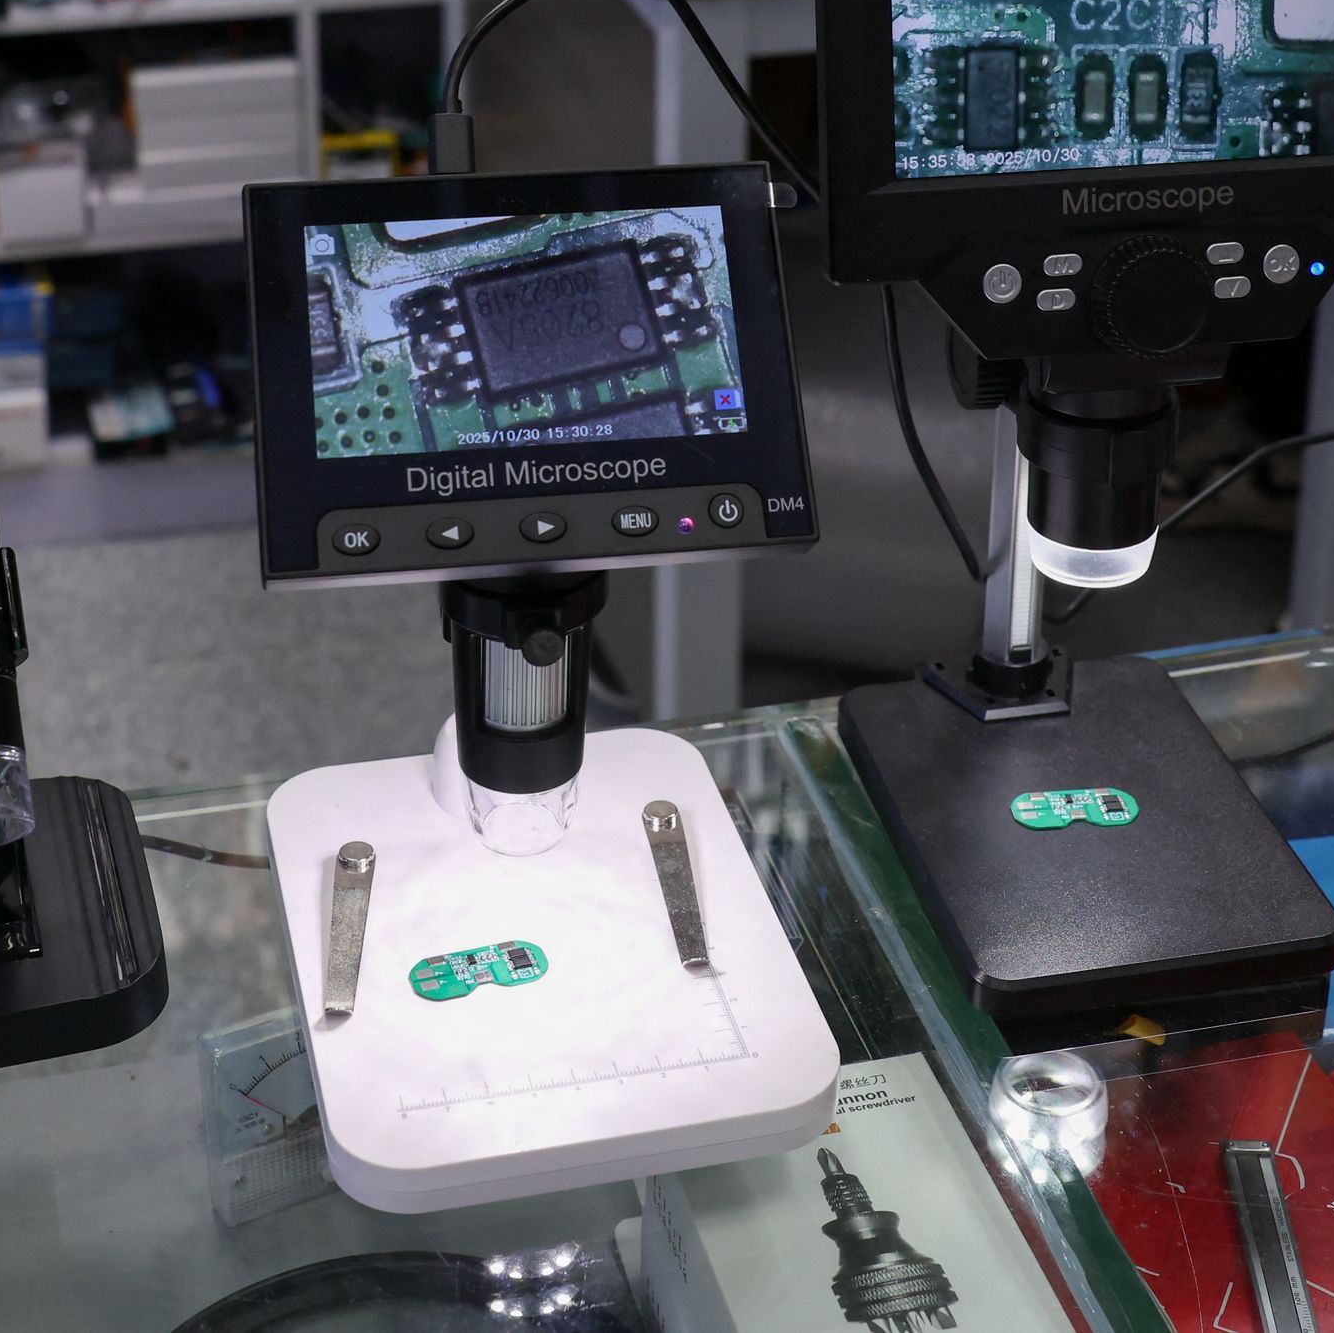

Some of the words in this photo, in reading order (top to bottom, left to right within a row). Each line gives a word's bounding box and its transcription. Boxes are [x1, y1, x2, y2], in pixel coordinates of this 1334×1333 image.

[986, 147, 1079, 166] 2025/10/30
[1062, 184, 1235, 215] Microscope
[457, 428, 540, 445] 2025/10/30
[547, 424, 613, 440] 15:30:28
[406, 461, 495, 496] Digital
[505, 456, 667, 486] Microscope
[768, 498, 805, 513] DM4
[620, 513, 652, 529] MENU
[344, 532, 369, 548] OK
[837, 1090, 888, 1106] annon
[848, 1095, 916, 1113] screwdriver
[1272, 1196, 1287, 1228] HARDENED
[1280, 1232, 1296, 1263] STAINLESS
